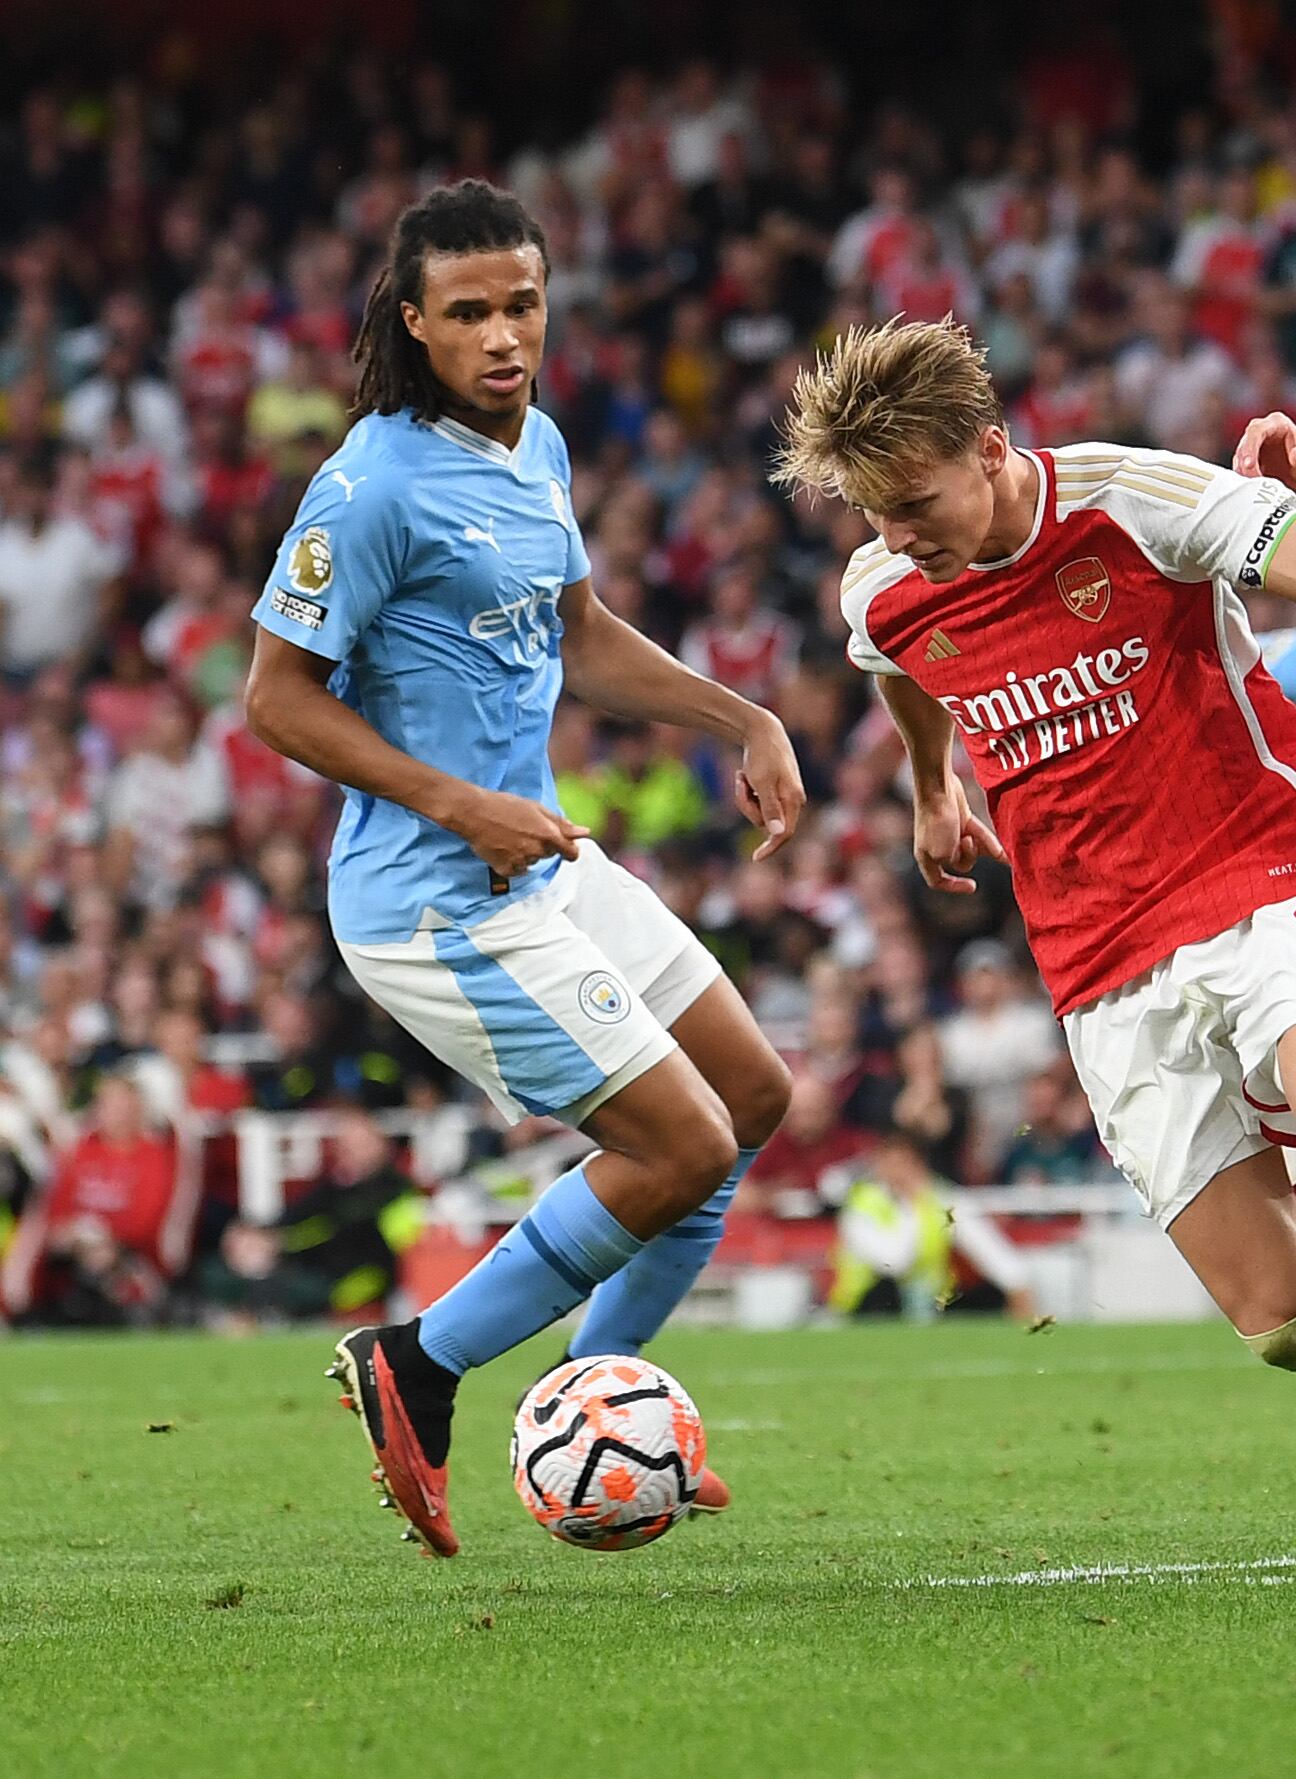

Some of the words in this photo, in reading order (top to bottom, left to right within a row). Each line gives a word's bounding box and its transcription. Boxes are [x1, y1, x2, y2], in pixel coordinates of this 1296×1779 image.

[1253, 481, 1278, 505] VIS
[936, 637, 1149, 735] Emirates
[1034, 690, 1139, 760] BETTER
